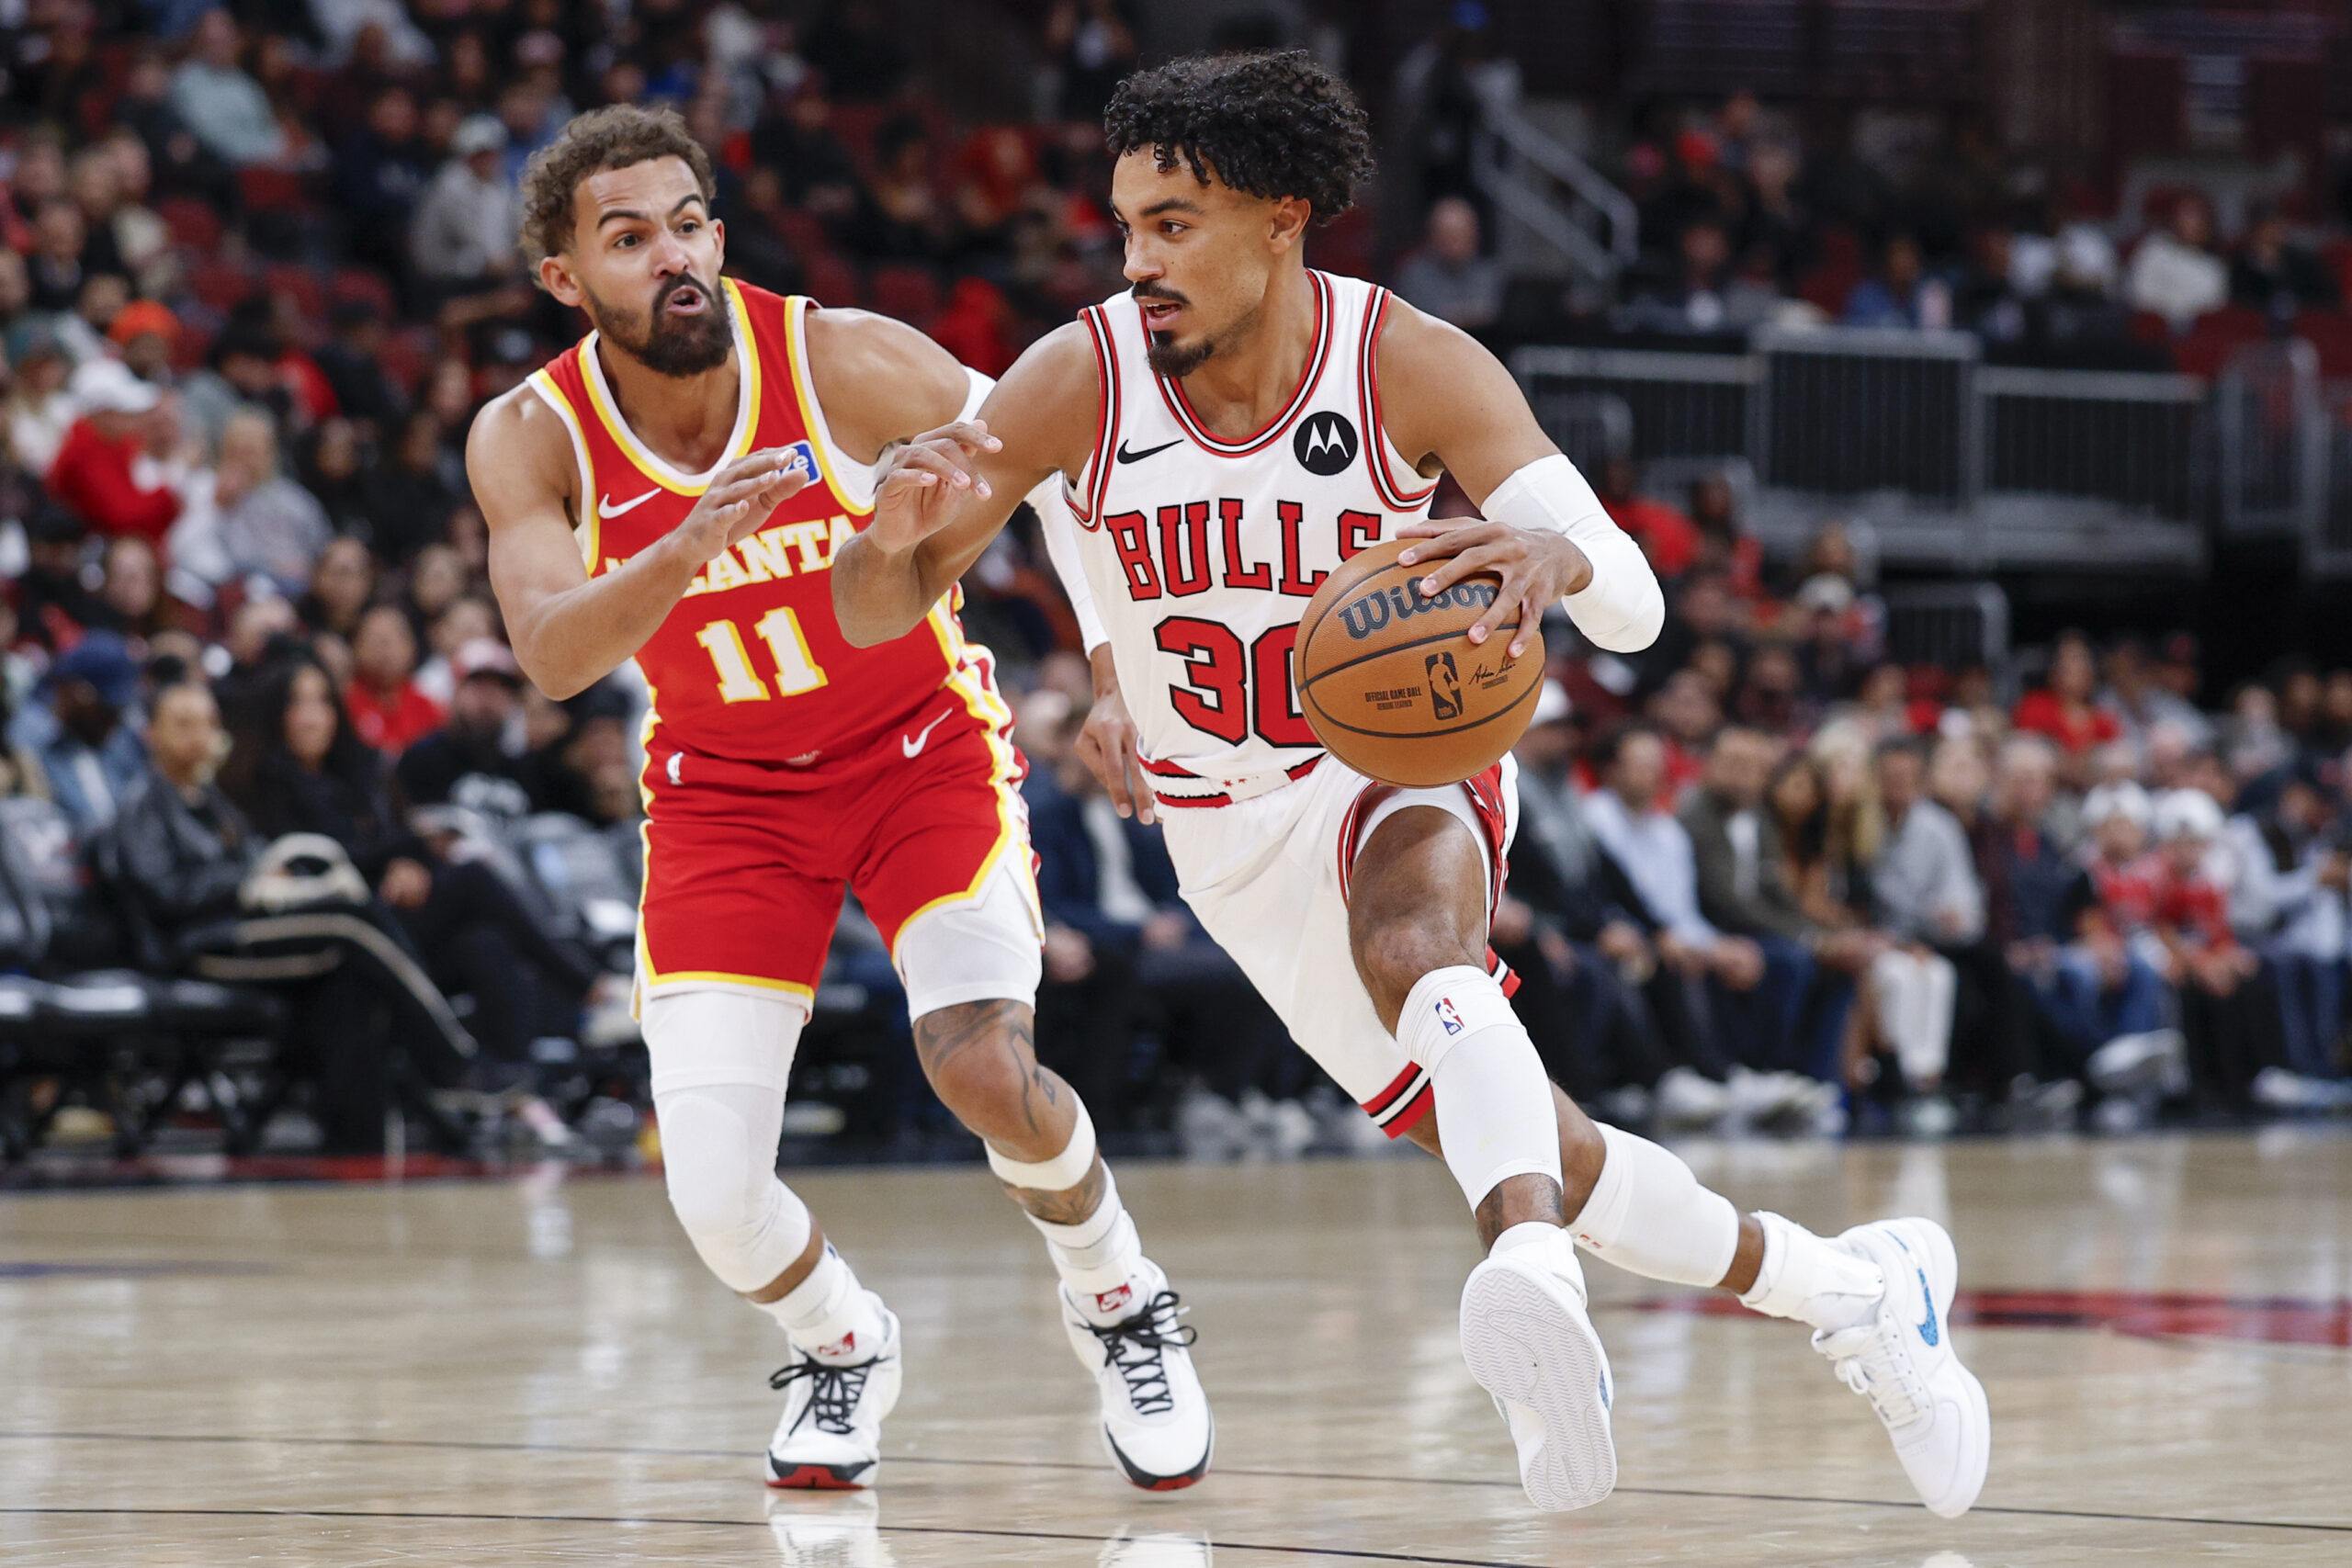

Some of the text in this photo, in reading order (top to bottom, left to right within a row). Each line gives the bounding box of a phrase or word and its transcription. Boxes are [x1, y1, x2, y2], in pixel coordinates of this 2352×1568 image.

[1103, 499, 1382, 602] BULLS
[695, 606, 829, 705] 11
[1338, 576, 1501, 640] Wilson
[1154, 615, 1324, 748] 30
[1364, 686, 1422, 702] OFFICIAL GAME BALL
